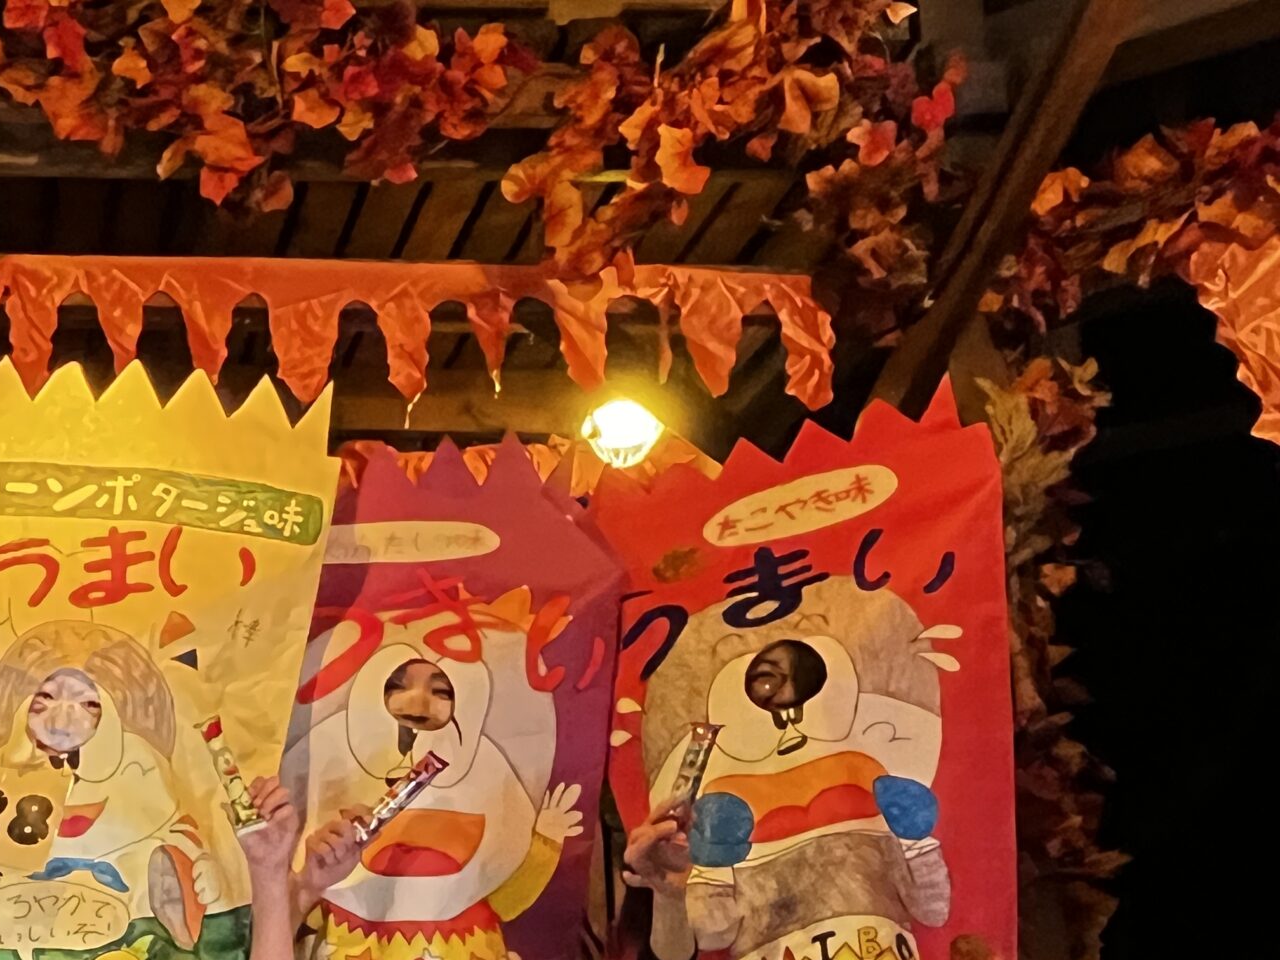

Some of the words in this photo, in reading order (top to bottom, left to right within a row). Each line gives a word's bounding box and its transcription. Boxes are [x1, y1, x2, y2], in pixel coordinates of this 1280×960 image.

[715, 474, 875, 541] たこやき味
[295, 567, 607, 704] うまい
[620, 528, 956, 682] うまい
